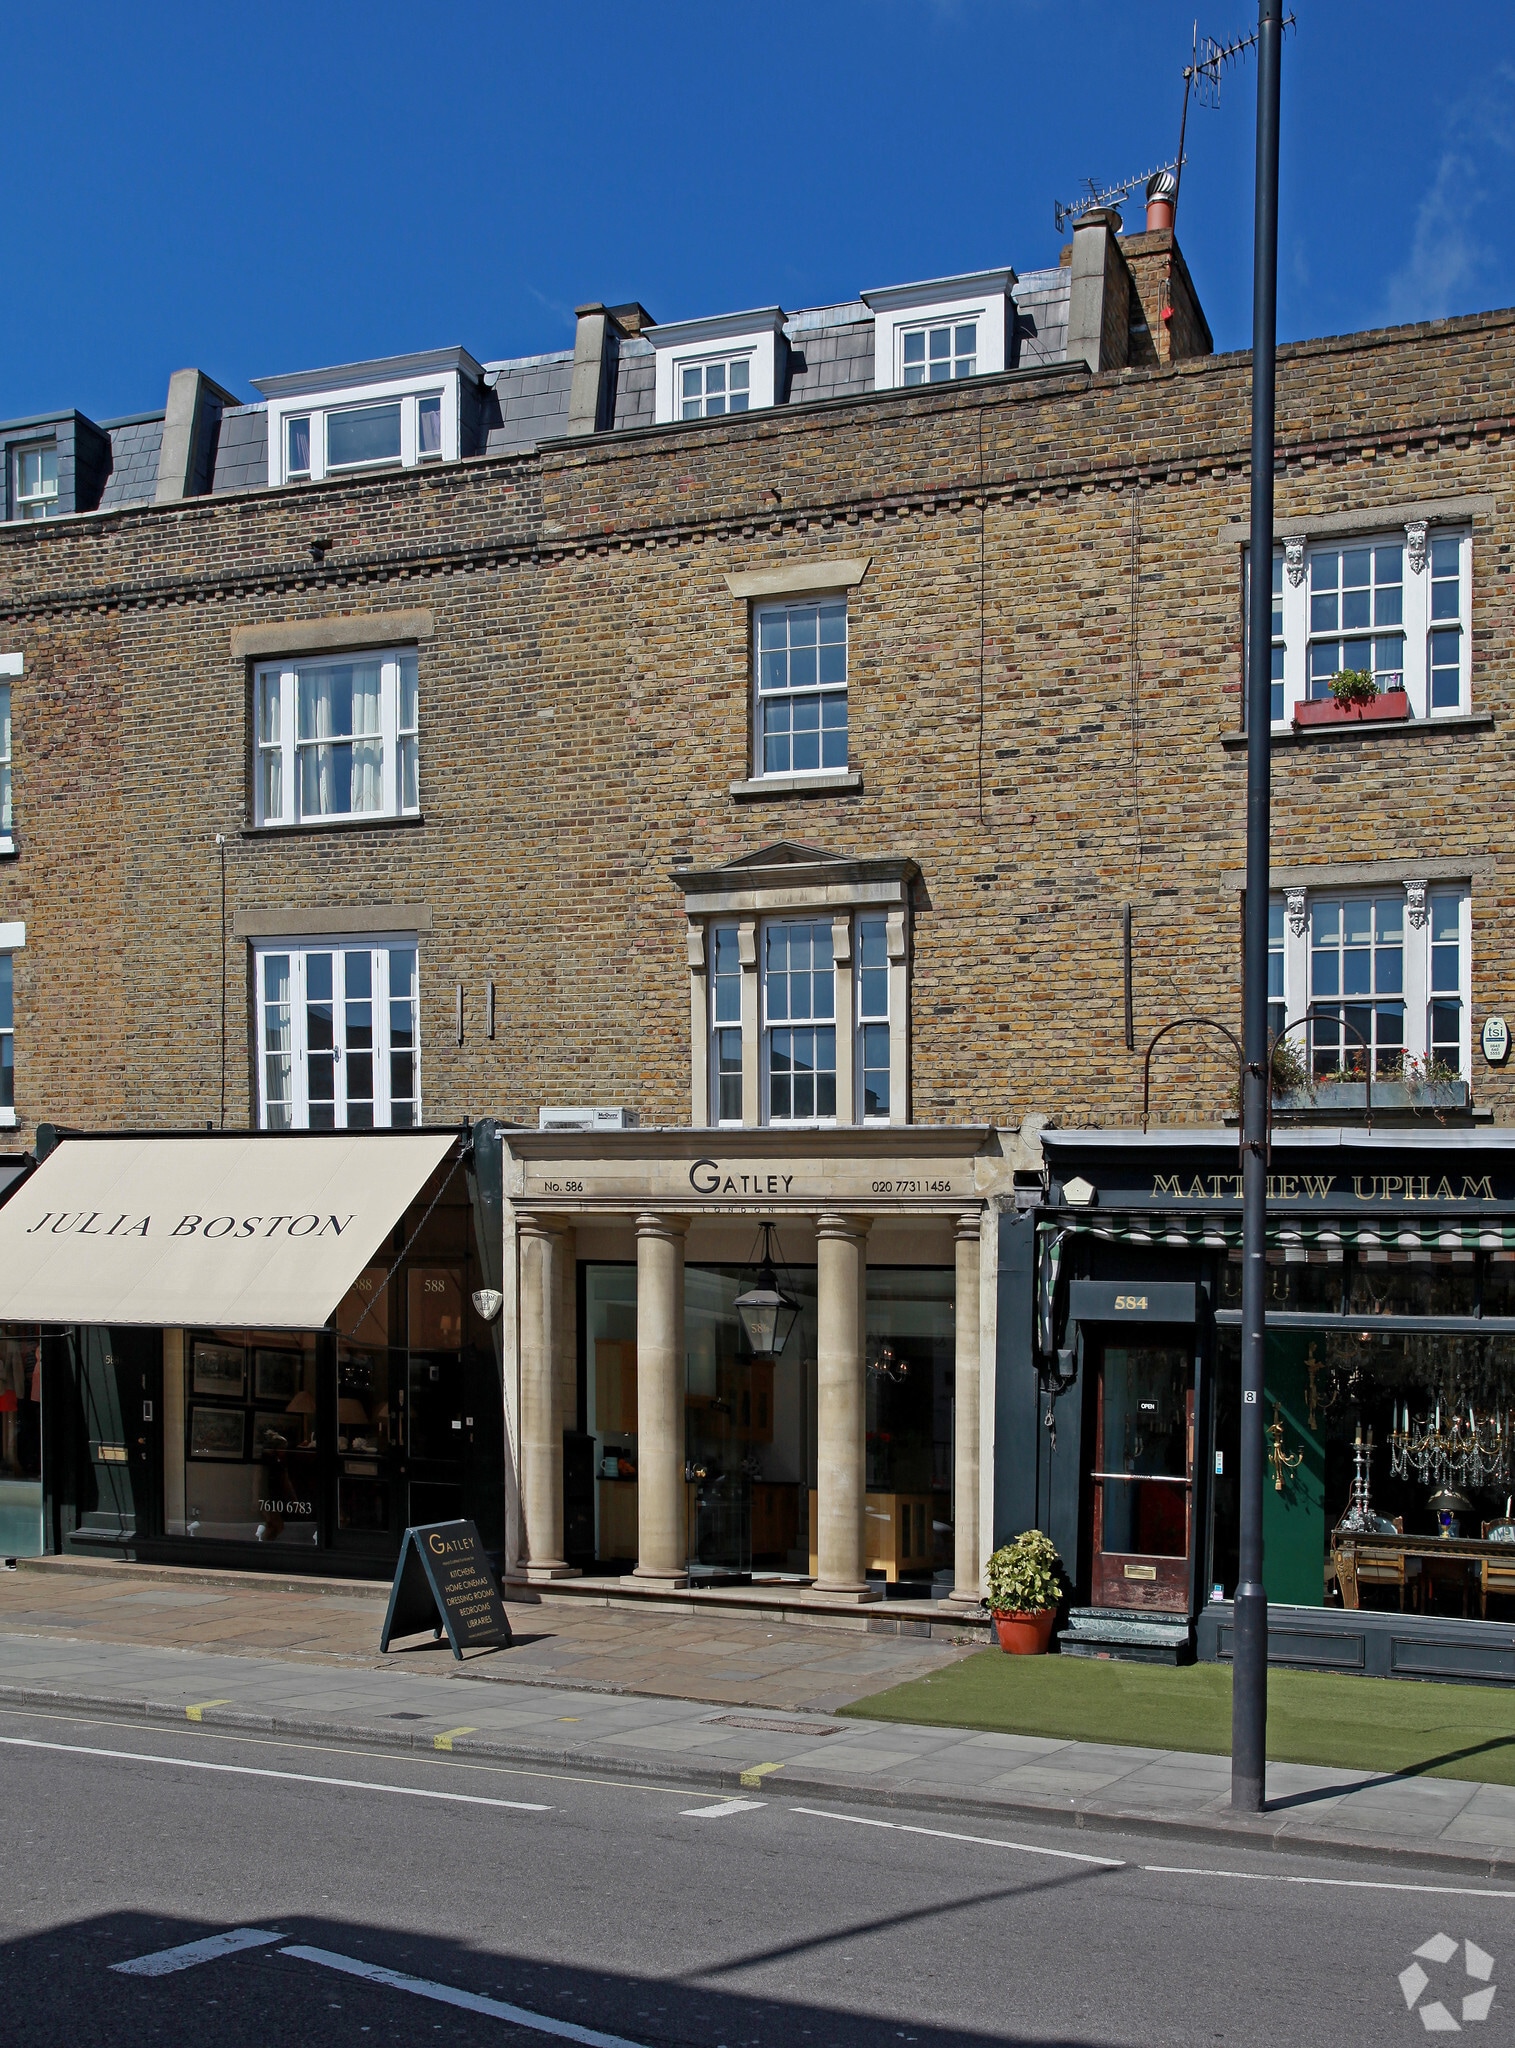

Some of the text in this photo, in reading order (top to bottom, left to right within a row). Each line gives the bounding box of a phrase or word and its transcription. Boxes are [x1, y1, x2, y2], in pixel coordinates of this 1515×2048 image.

[1488, 1026, 1503, 1037] tsi
[689, 1158, 793, 1194] GATLEY
[544, 1181, 583, 1192] No. 586
[871, 1181, 951, 1193] 020 7731 1456
[1350, 1175, 1498, 1200] UPHAM
[26, 1212, 357, 1238] JULIA BOSTON
[424, 1279, 445, 1292] 588
[1114, 1295, 1148, 1310] 584
[1246, 1392, 1254, 1402] 8
[258, 1499, 312, 1514] 7610 6783
[429, 1533, 475, 1555] GATLEY
[449, 1566, 476, 1579] KITCHENS
[445, 1576, 488, 1593] HOME CINEMAS
[446, 1588, 495, 1606] DRESSING ROOMS
[459, 1602, 491, 1617] BEDROOMS
[466, 1615, 492, 1629] LIBRARIES
